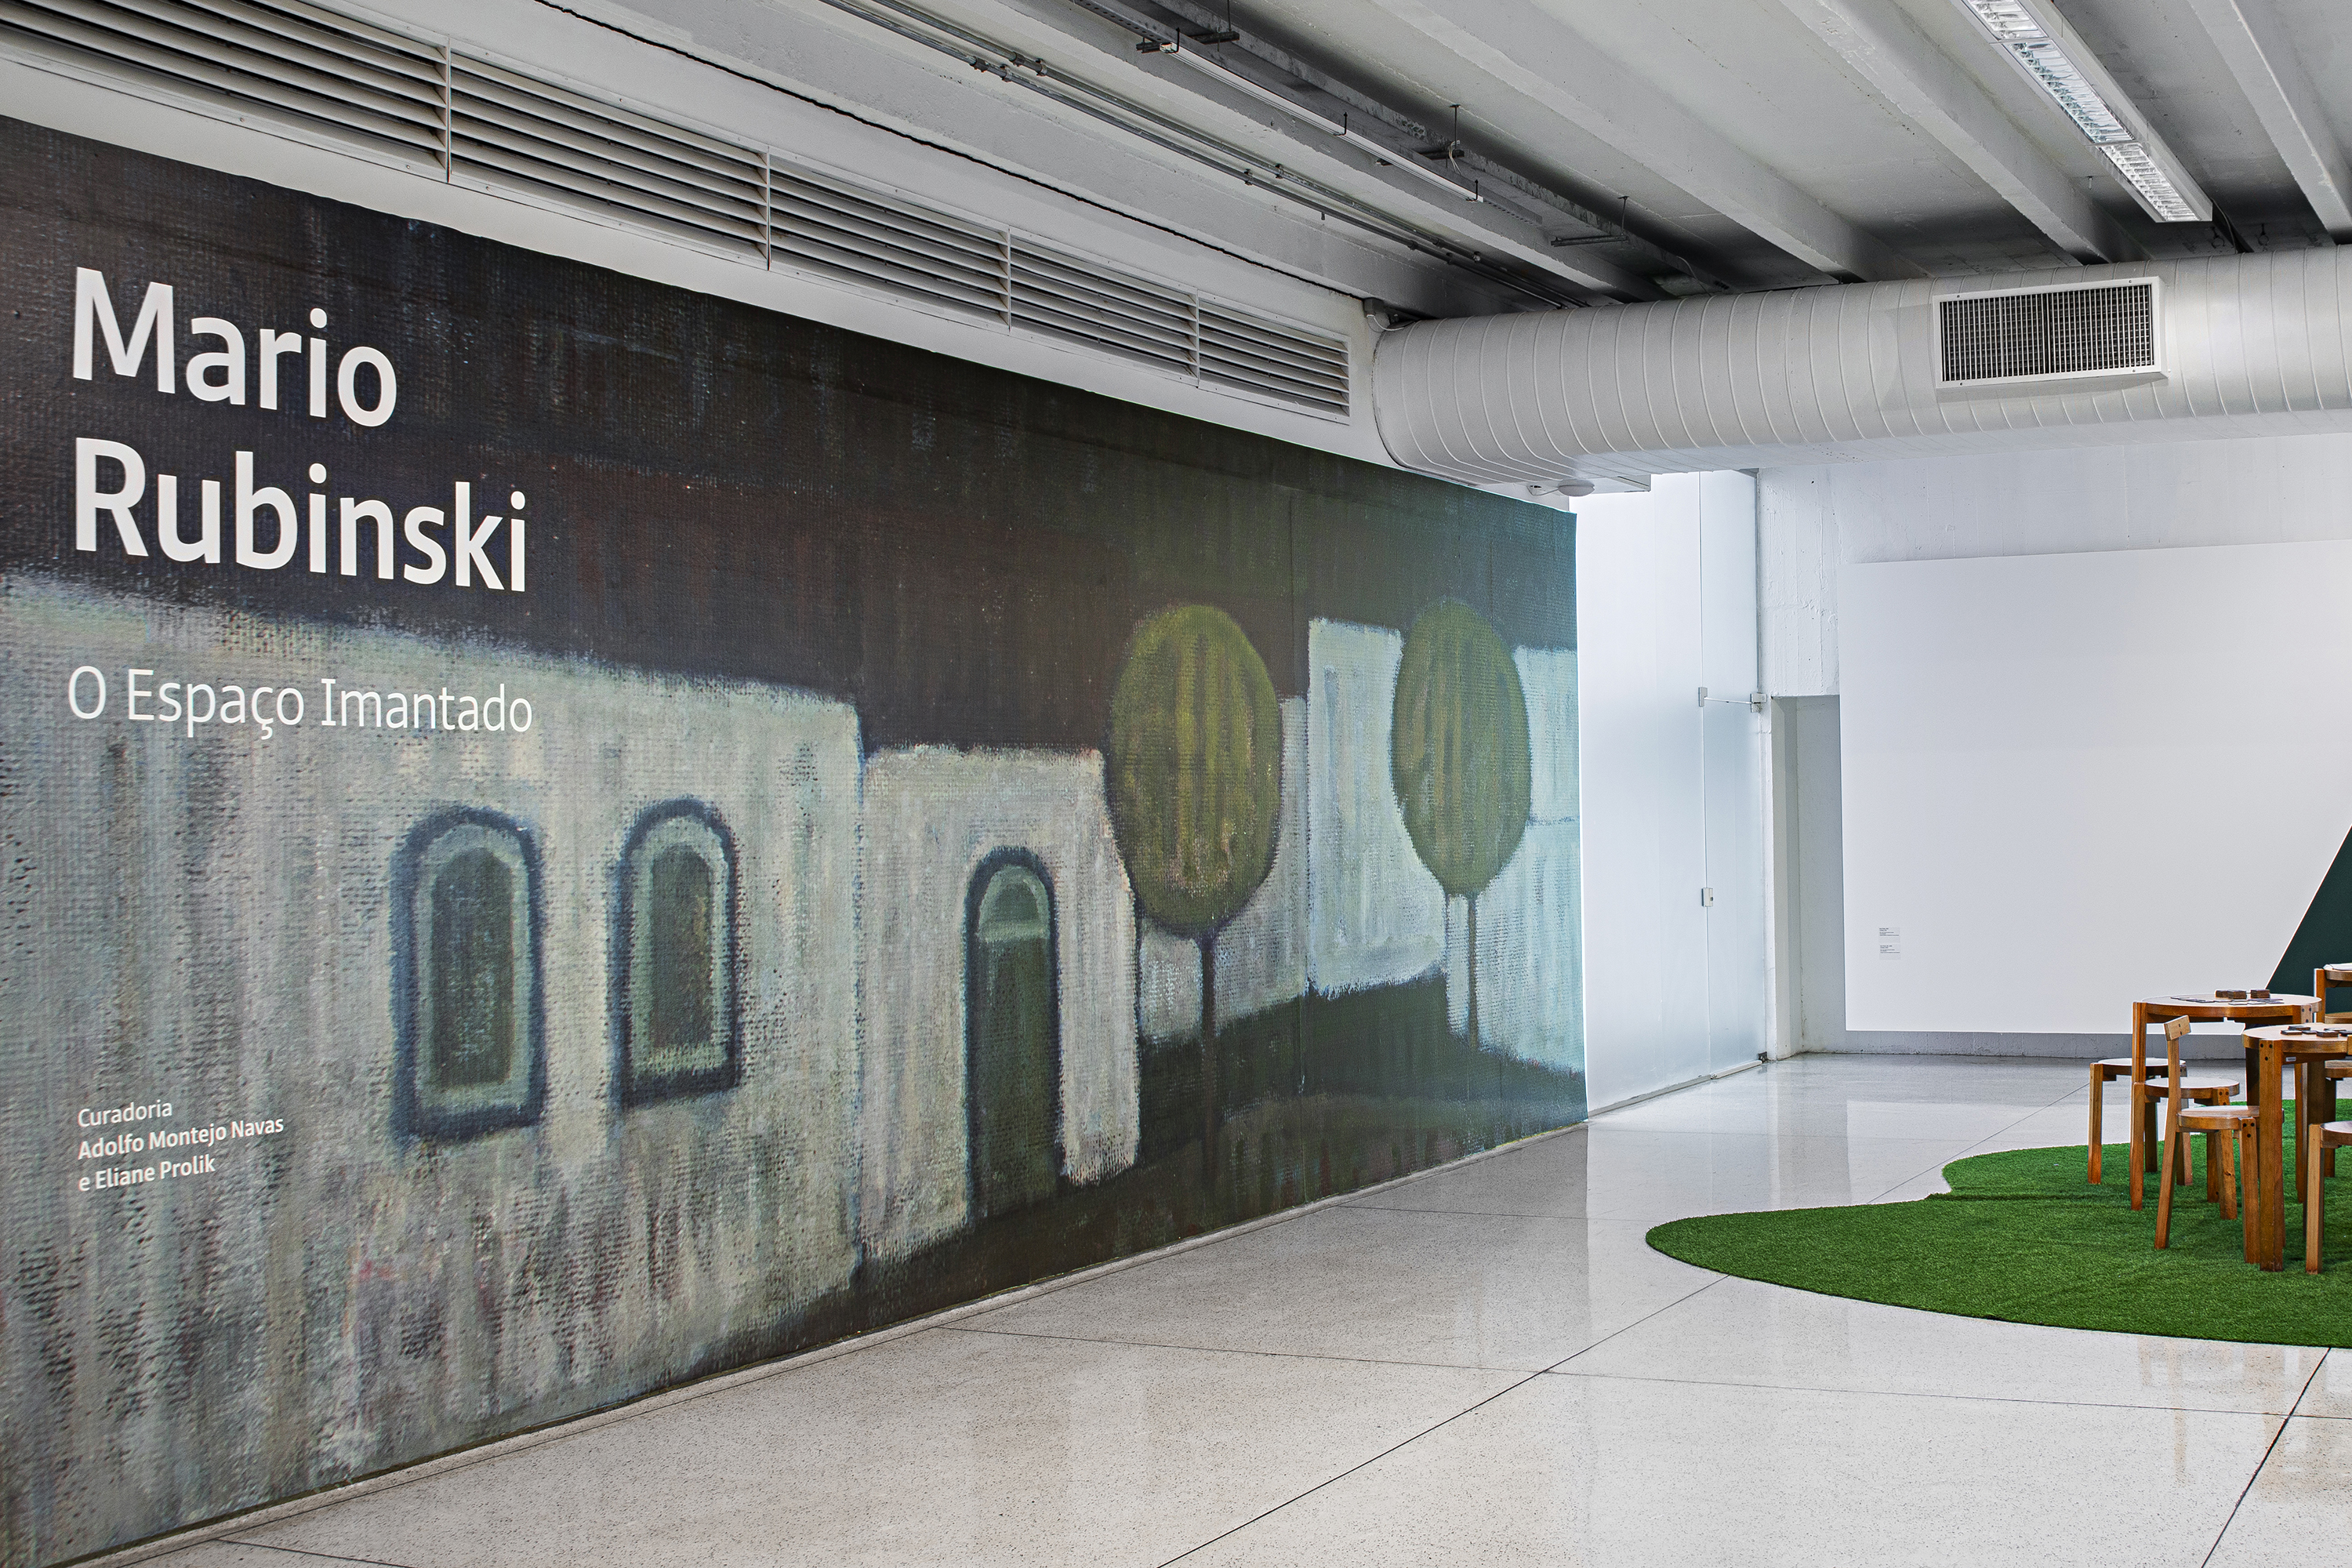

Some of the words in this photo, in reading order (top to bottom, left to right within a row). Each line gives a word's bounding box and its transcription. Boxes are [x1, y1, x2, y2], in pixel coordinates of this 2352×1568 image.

[74, 267, 397, 426] Mario
[76, 437, 525, 592] Rubinski
[68, 666, 106, 719] O
[128, 669, 304, 739] Espaço
[321, 678, 532, 732] Imantado
[78, 1099, 172, 1127] Curadoria
[78, 1134, 144, 1160] Adolfo
[148, 1123, 227, 1150] Montejo
[231, 1118, 284, 1138] Navas
[79, 1176, 90, 1192] e
[95, 1166, 155, 1189] Eliane
[159, 1153, 216, 1179] Prolik
